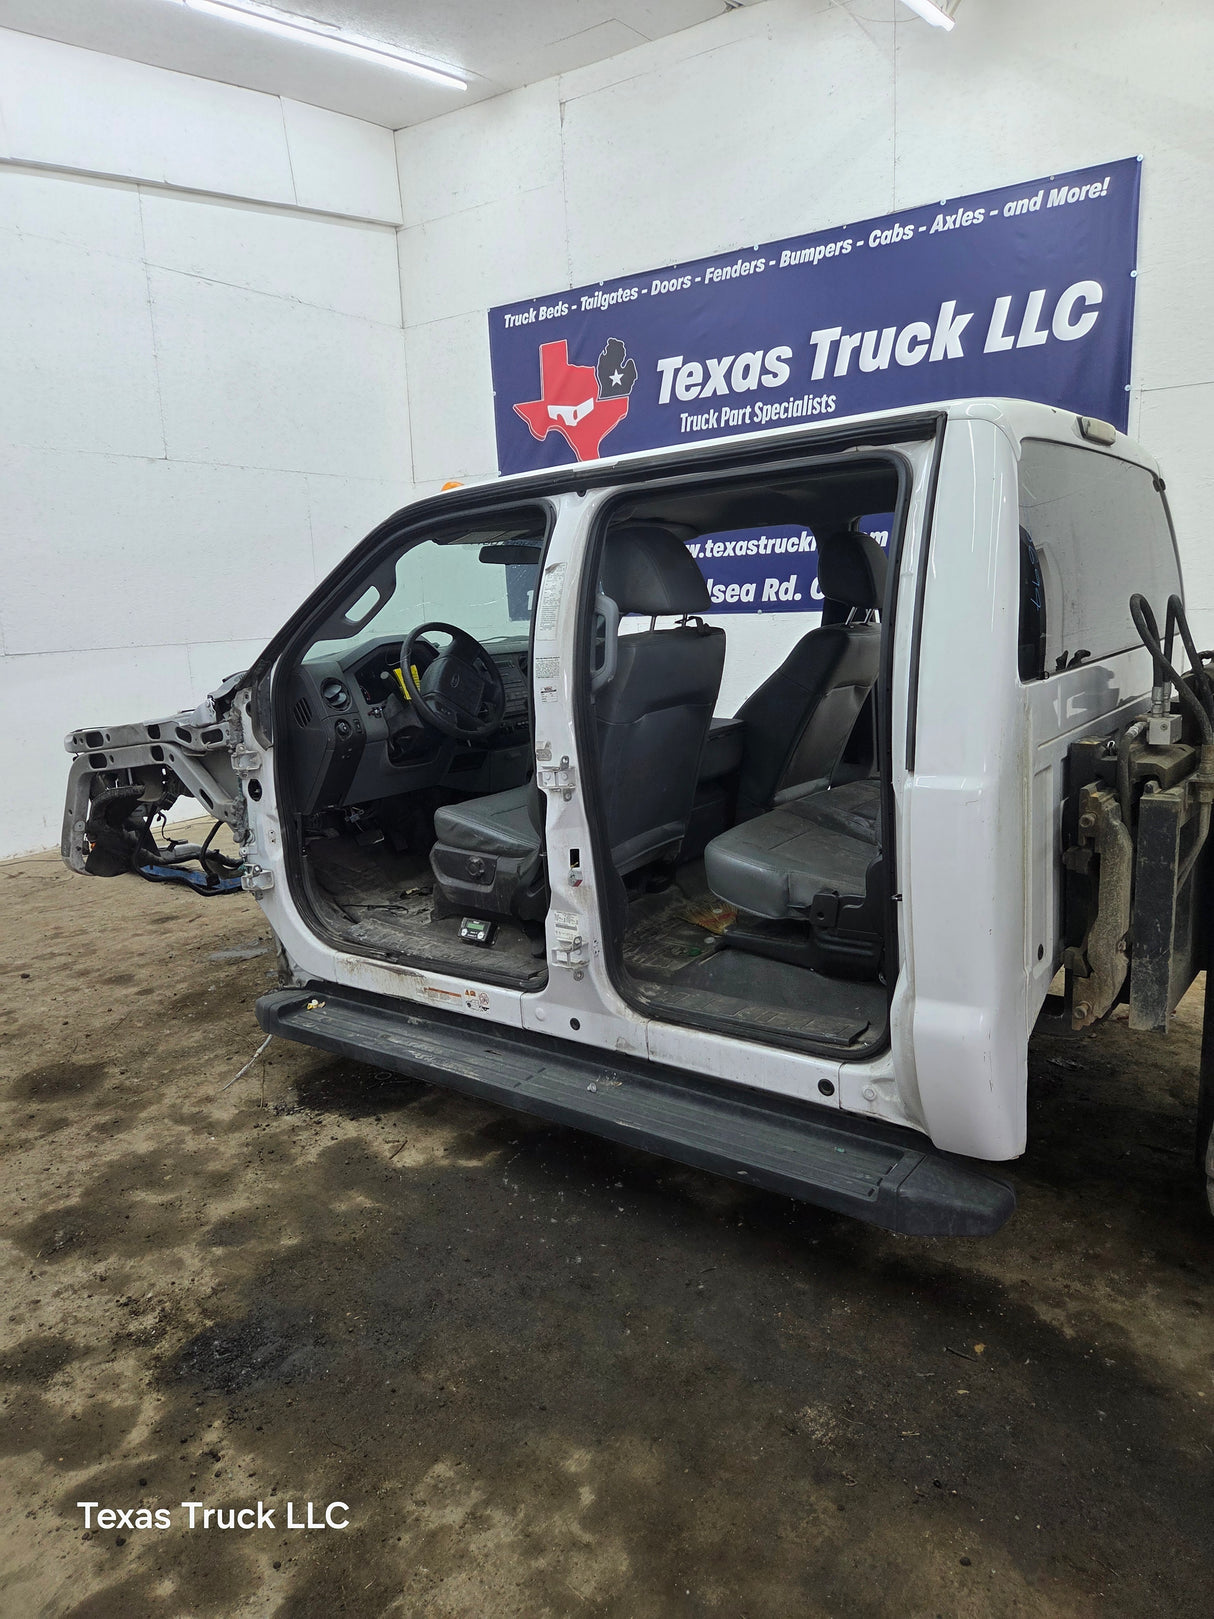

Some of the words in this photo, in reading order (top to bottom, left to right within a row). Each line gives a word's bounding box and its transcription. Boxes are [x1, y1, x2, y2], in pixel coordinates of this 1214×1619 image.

[503, 308, 536, 329] Truck
[538, 301, 569, 321] Beds
[580, 286, 638, 312] Tailgates
[650, 274, 692, 296] Doors
[704, 257, 765, 285] Fenders
[779, 238, 853, 267] Bumpers
[868, 223, 915, 248] Cabs
[929, 207, 985, 234] Axles
[1003, 190, 1043, 217] and
[1046, 176, 1111, 209] More!
[656, 345, 793, 405] Texas
[810, 299, 975, 381] Truck
[983, 280, 1104, 354] LLC
[680, 408, 718, 433] Truck
[720, 404, 753, 429] Part
[753, 393, 837, 425] Specialists
[761, 574, 802, 602] Rd.
